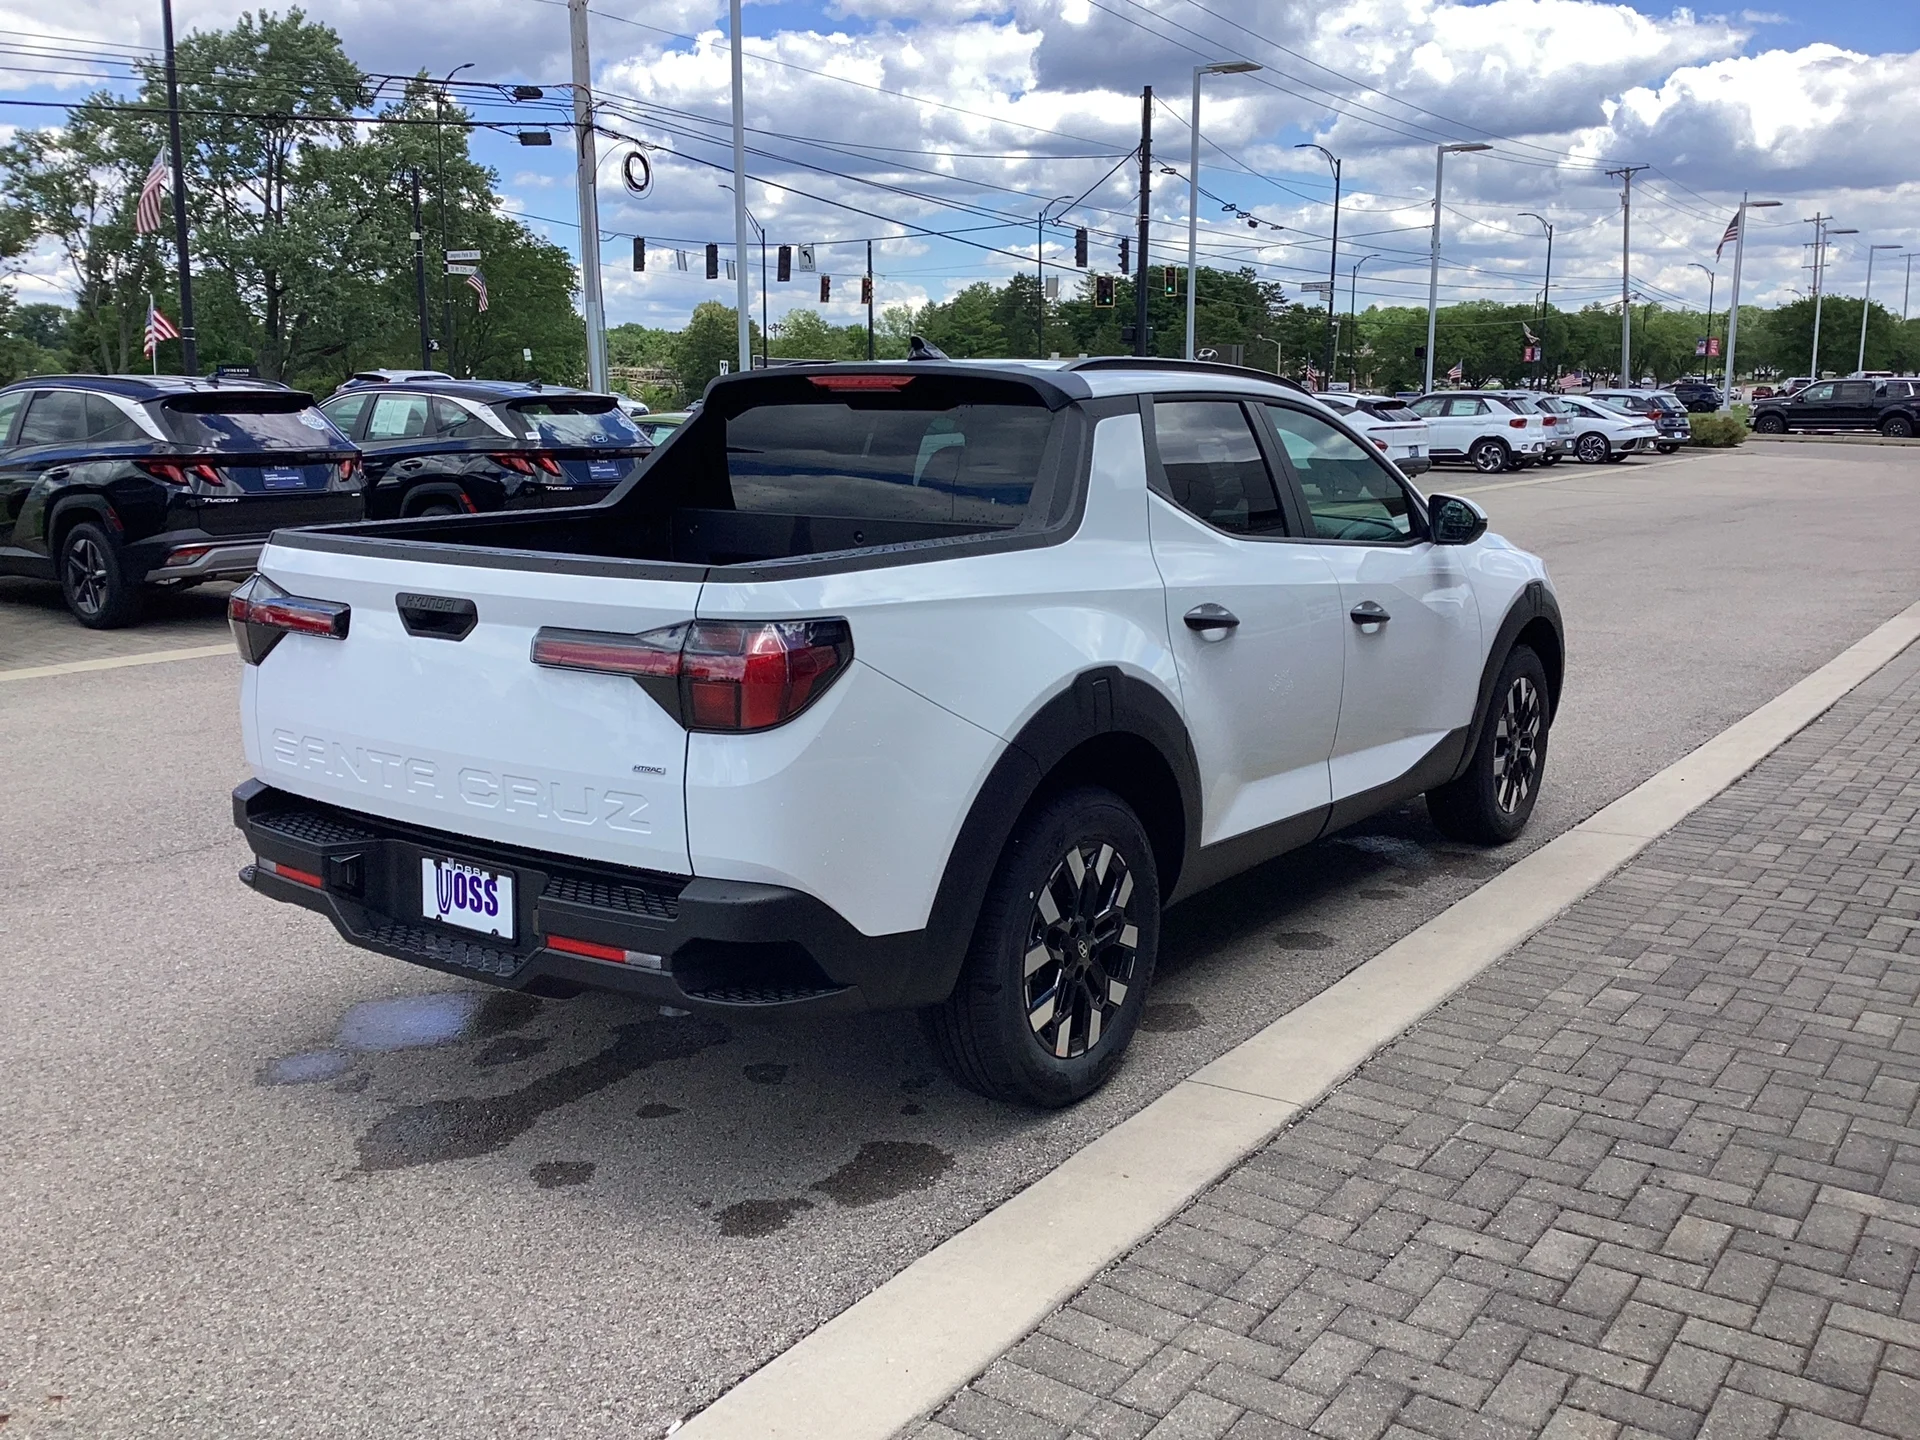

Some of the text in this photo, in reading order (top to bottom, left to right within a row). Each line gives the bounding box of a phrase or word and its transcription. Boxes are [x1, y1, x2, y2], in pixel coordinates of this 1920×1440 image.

[405, 595, 457, 611] HYUNDAI
[272, 727, 652, 834] SANTA CRUZ
[633, 764, 664, 775] HTRAC
[435, 866, 499, 917] VOSS
